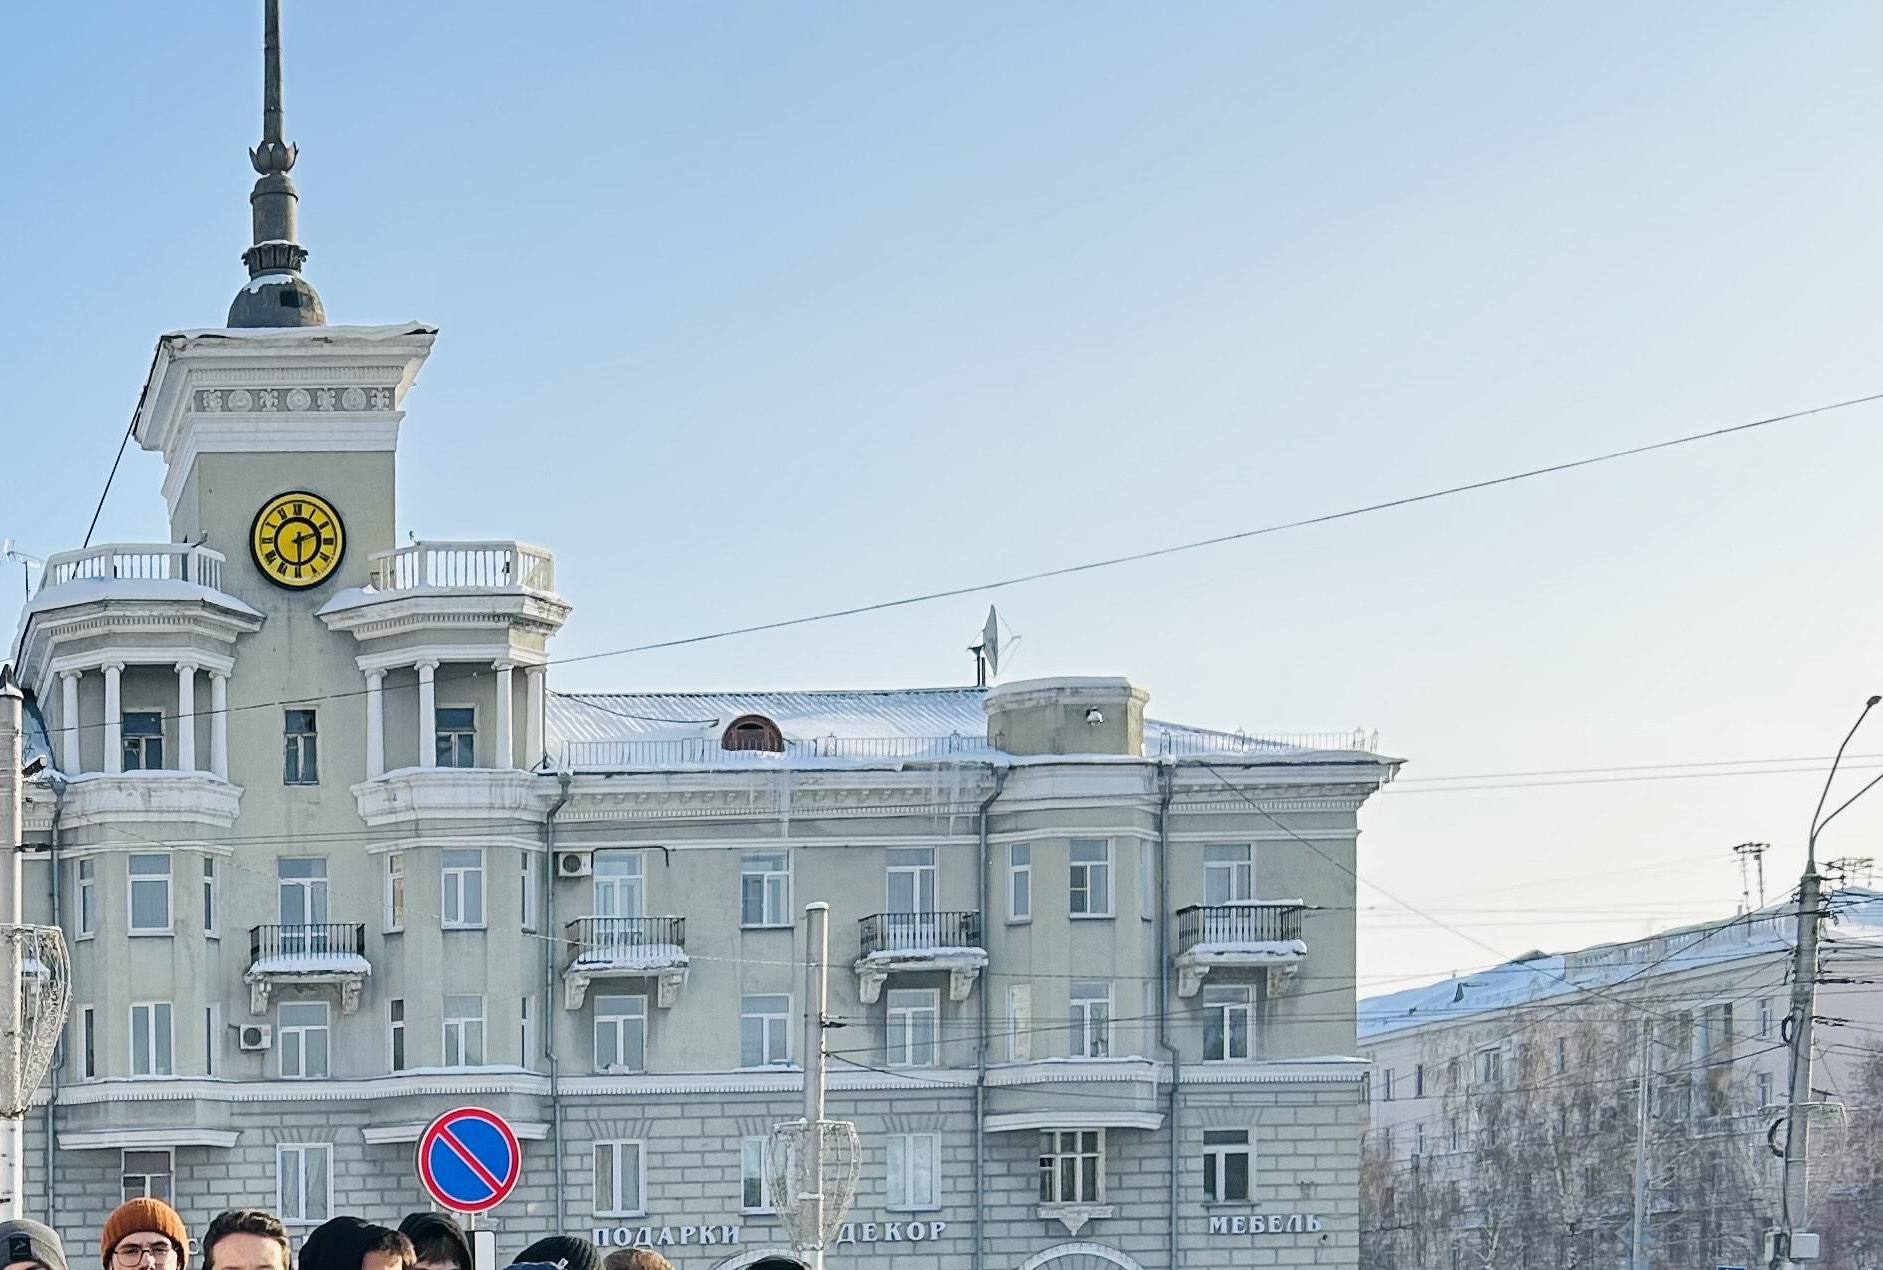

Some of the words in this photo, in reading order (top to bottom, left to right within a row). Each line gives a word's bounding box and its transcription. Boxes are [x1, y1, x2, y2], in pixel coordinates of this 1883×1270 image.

[592, 1225, 741, 1248] ПОДАРКИ
[835, 1221, 948, 1246] ДЕКОР
[1208, 1213, 1323, 1235] МЕБЕЛЬ
